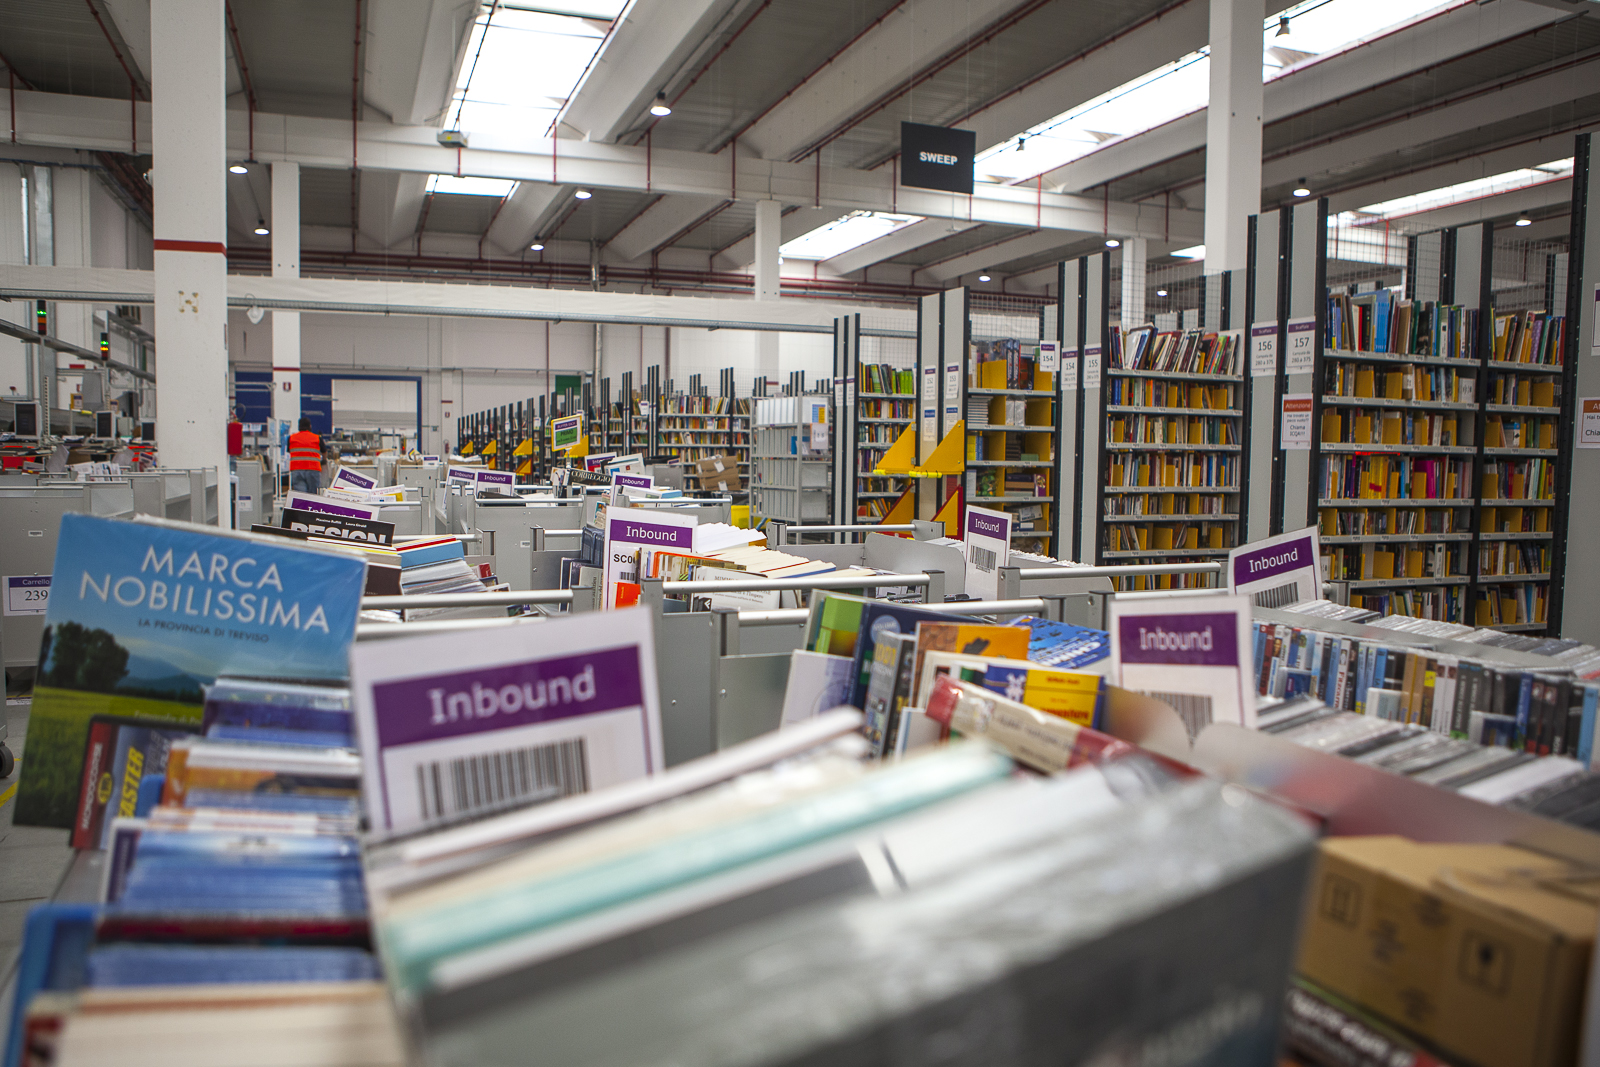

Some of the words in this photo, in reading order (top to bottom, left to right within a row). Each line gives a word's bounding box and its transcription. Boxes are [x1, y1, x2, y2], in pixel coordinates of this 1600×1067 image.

[919, 151, 958, 166] SWEEP
[1258, 341, 1272, 351] 156
[1294, 337, 1310, 348] 157
[1088, 359, 1098, 368] 155
[345, 473, 368, 487] Inbound
[454, 471, 474, 479] Inbound
[484, 474, 506, 482] Inbound
[571, 470, 611, 483] CORREGGIO
[622, 478, 645, 486] Inbound
[975, 518, 1000, 533] Inbound
[626, 525, 677, 542] Inbound
[1249, 548, 1298, 573] Inbound
[140, 545, 283, 592] MARCA
[24, 589, 49, 601] 239
[79, 570, 330, 634] NOBILISSIMA
[138, 618, 151, 628] LA
[154, 620, 211, 636] PROVINCIA
[214, 628, 225, 638] DI
[228, 629, 269, 643] TREVISO
[1138, 625, 1213, 651] Inbound
[427, 663, 596, 725] Inbound
